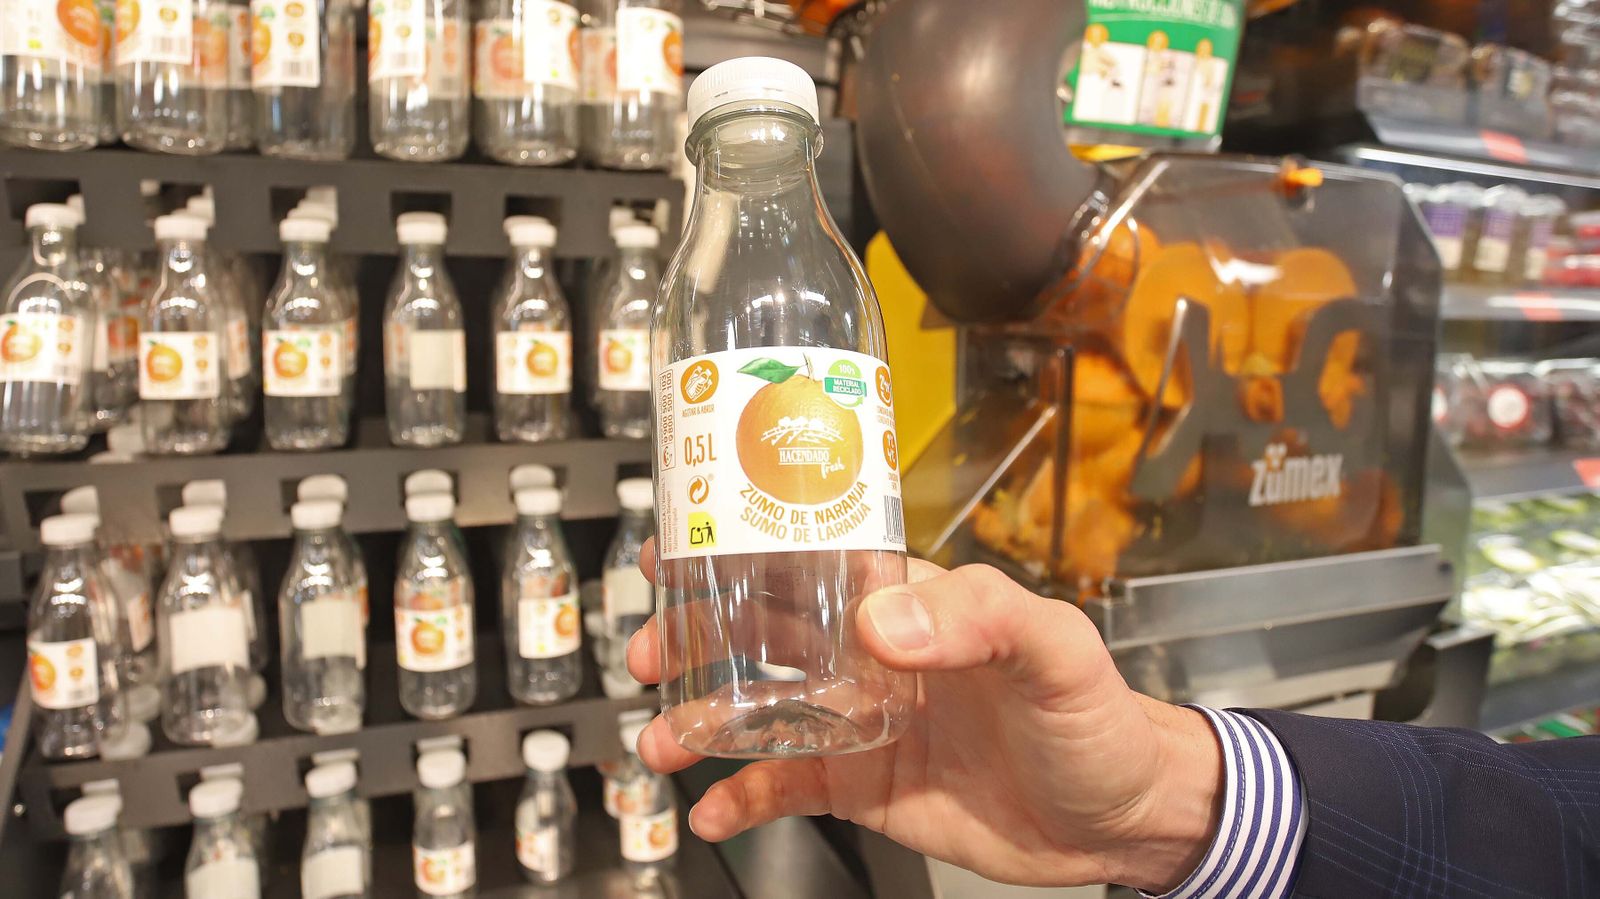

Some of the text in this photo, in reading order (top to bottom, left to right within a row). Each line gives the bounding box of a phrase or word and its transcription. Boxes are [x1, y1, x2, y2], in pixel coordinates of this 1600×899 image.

[832, 385, 863, 395] RECICLADO
[833, 378, 860, 388] MATERIAL
[684, 432, 717, 467] 0,5 L
[779, 449, 830, 463] HACENDADO
[821, 456, 846, 479] fresh
[740, 481, 868, 526] ZUMO DE NARANJA
[740, 502, 871, 543] SUMO DE LARANJA
